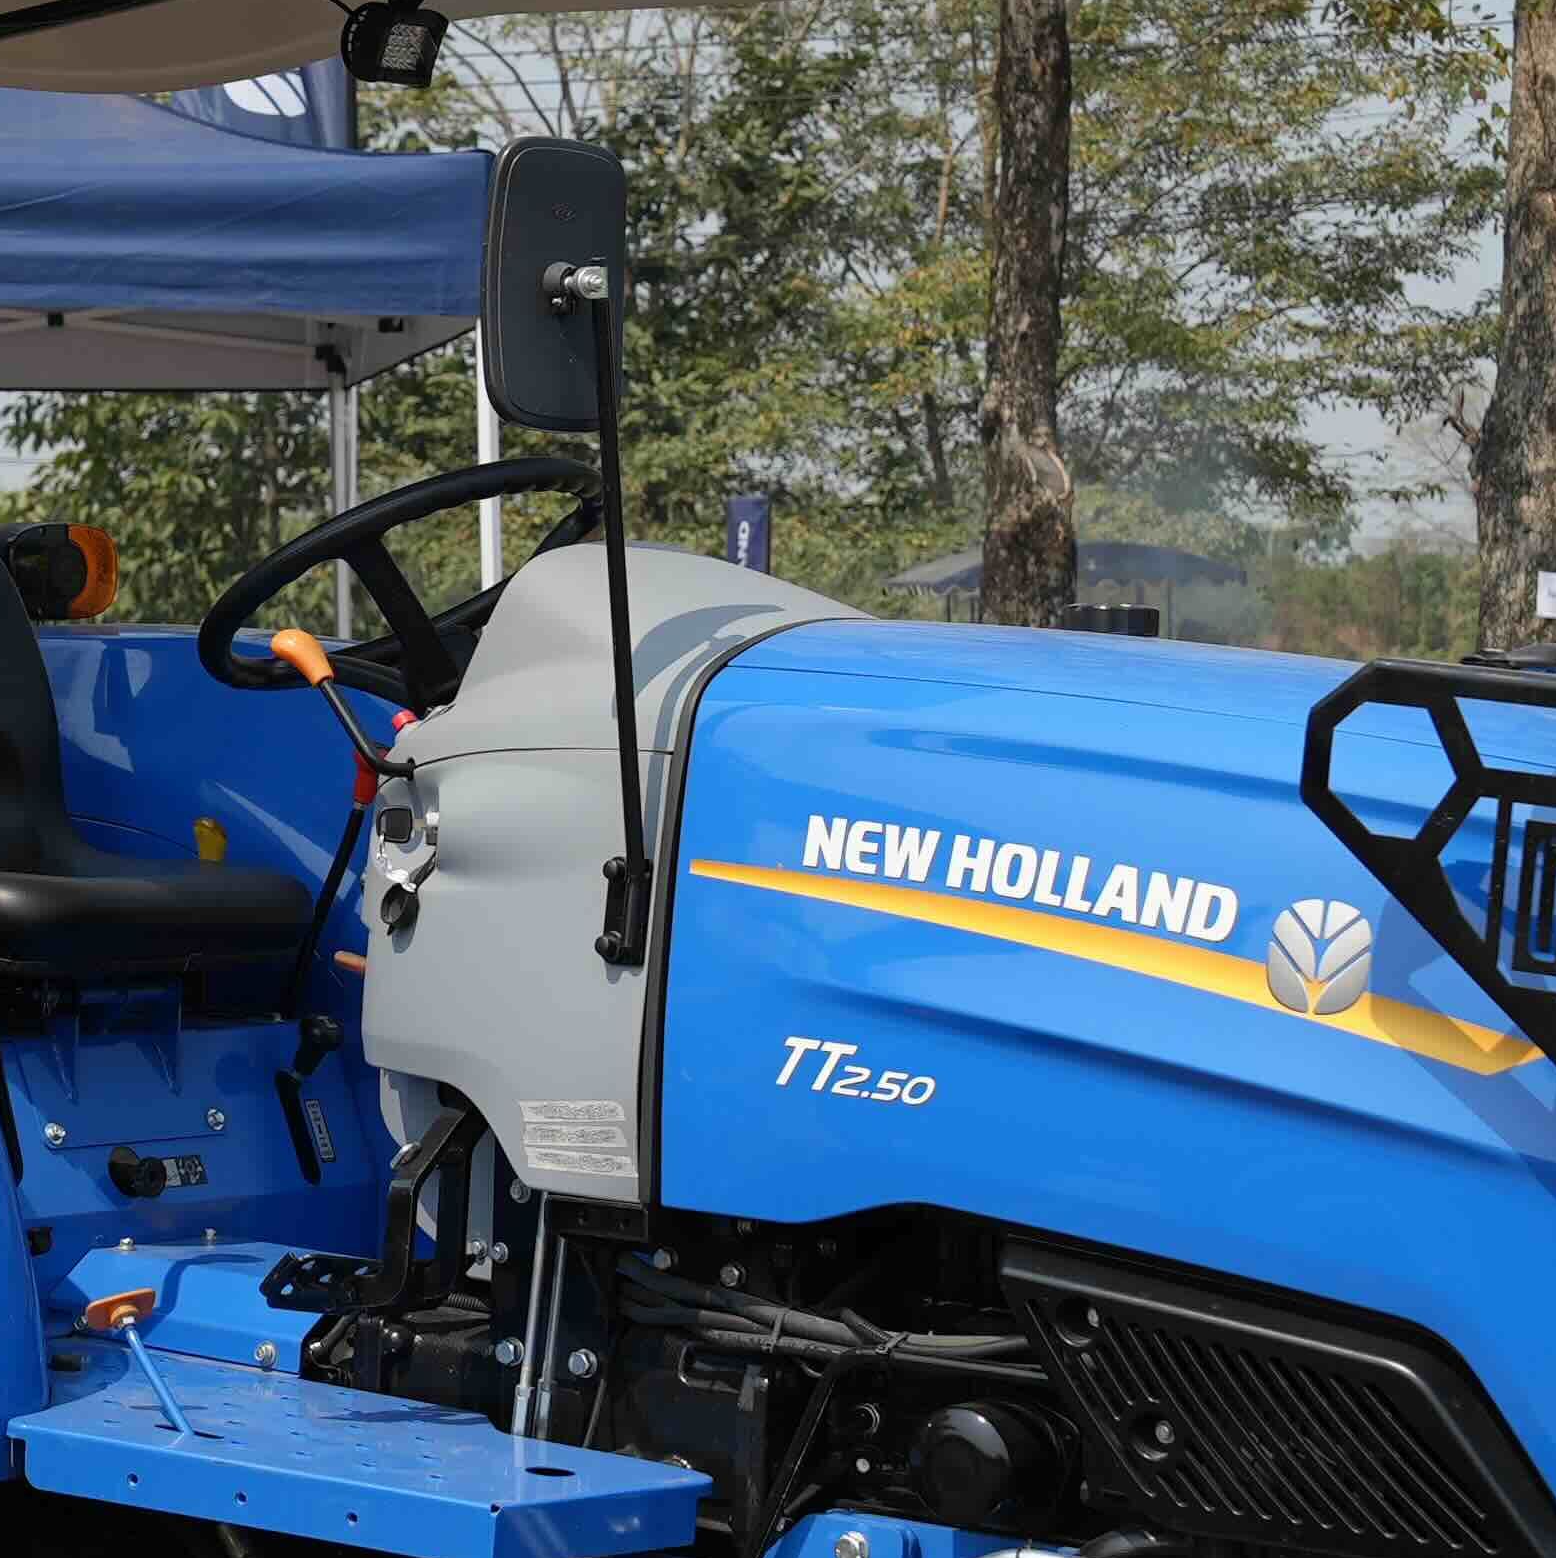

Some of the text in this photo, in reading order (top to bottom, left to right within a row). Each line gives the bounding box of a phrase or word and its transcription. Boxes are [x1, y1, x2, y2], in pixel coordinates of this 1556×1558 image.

[803, 815, 1238, 944] NEW HOLLAND
[774, 1036, 936, 1106] TT2.50
